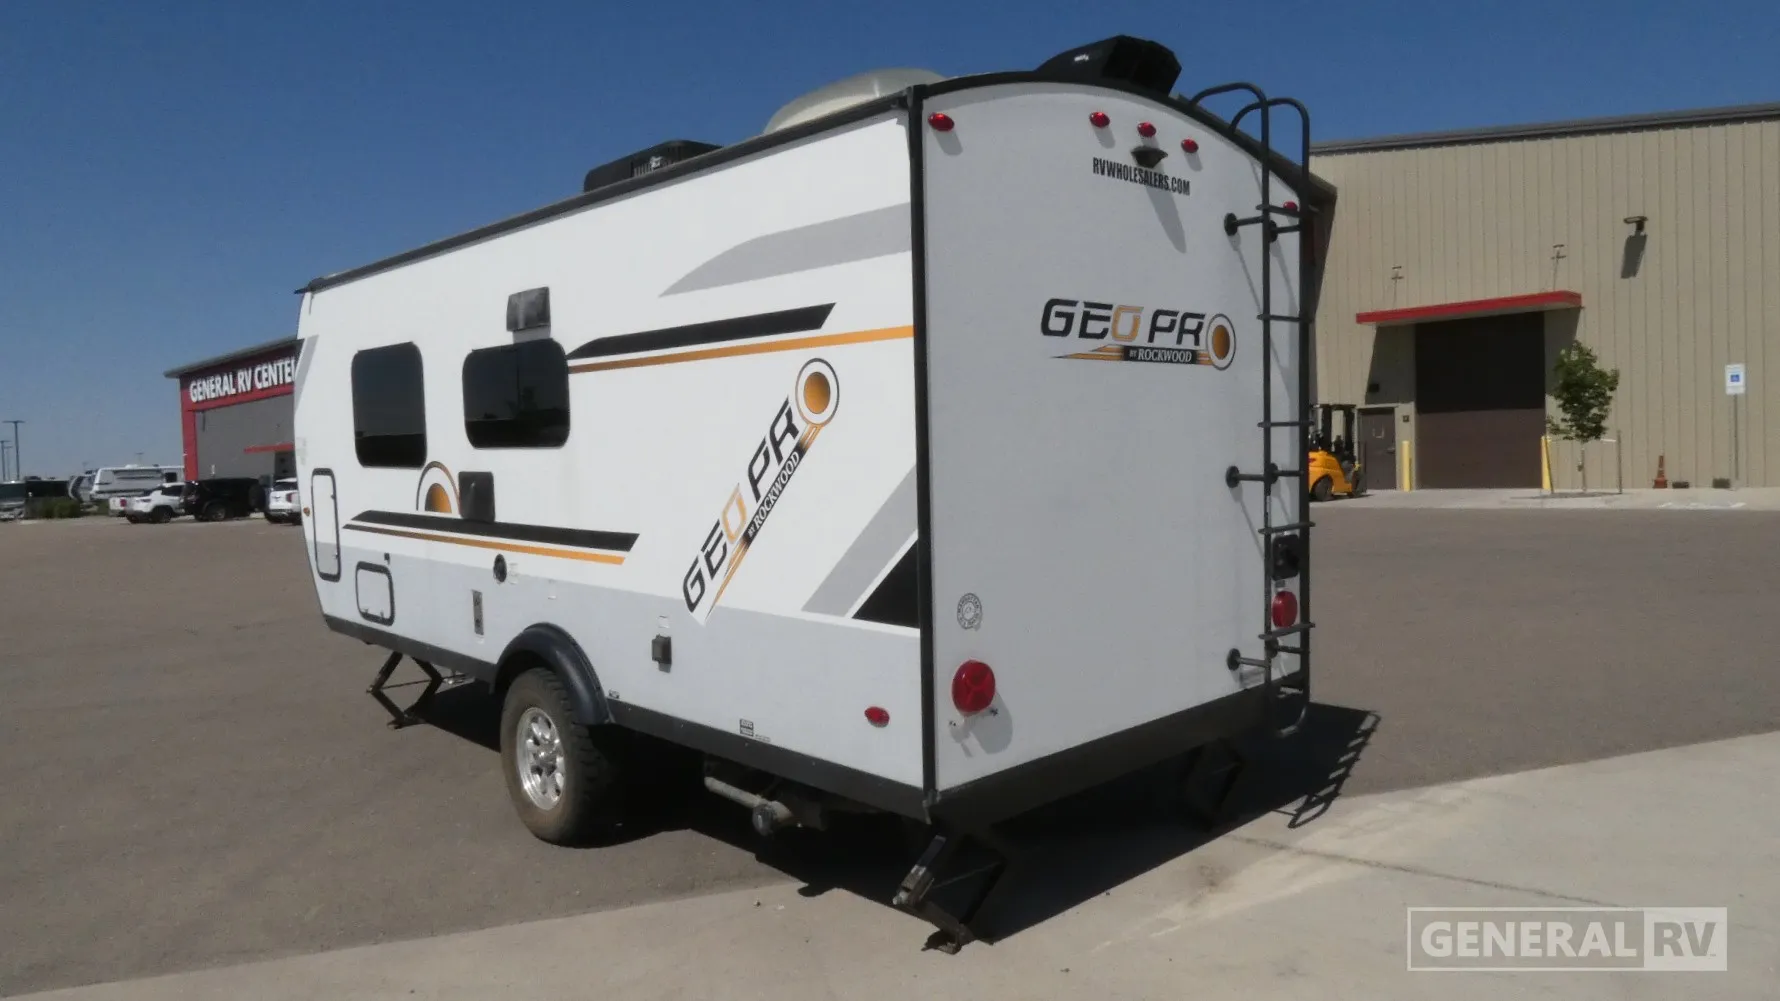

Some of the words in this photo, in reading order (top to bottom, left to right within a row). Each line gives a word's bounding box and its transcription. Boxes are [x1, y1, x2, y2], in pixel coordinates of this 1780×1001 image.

[1093, 157, 1190, 196] RVWHOLESALERS.COM
[1041, 298, 1144, 342] GEO
[1137, 348, 1192, 363] ROCKWOOD
[190, 372, 236, 402] GENERAL
[237, 367, 252, 393] RV
[753, 451, 800, 526] ROCKWOOD
[683, 483, 747, 613] GEO
